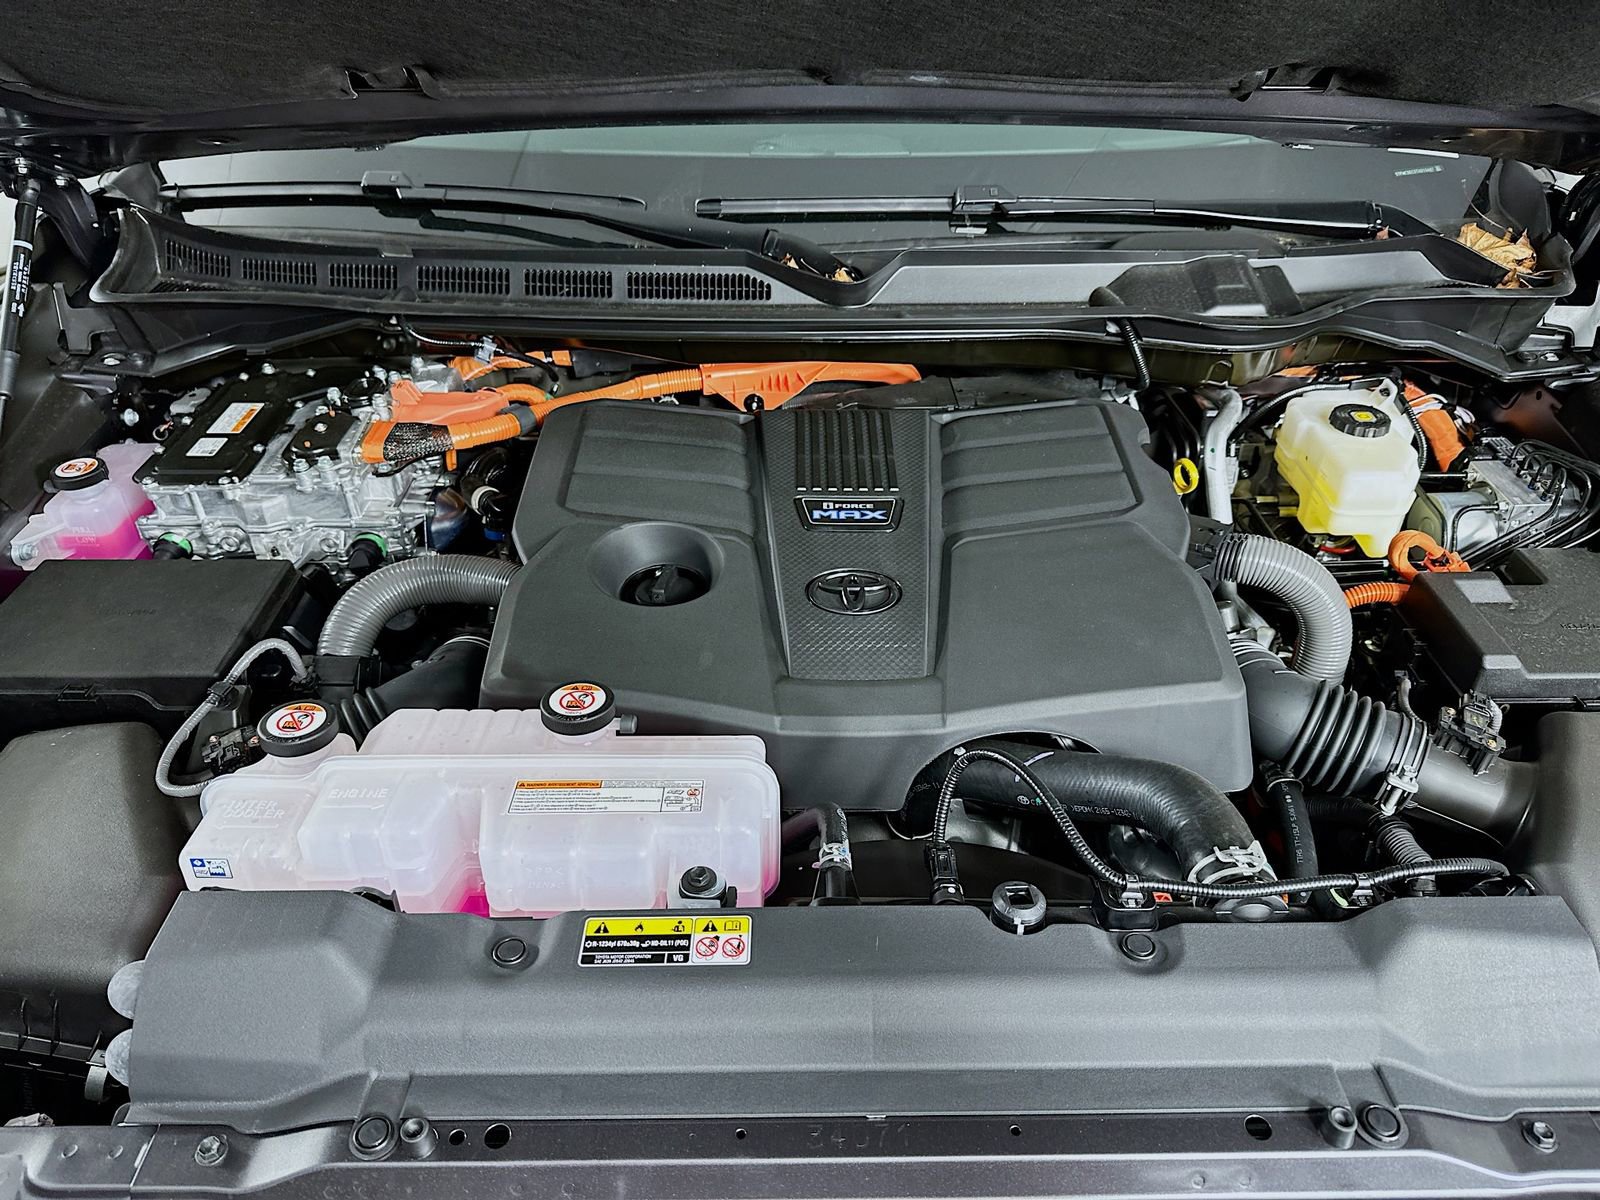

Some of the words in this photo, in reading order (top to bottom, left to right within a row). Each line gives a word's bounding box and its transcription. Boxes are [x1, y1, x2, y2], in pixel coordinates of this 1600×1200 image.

[812, 510, 888, 520] MAX
[327, 787, 390, 799] ENGINE
[223, 809, 286, 819] COOLER
